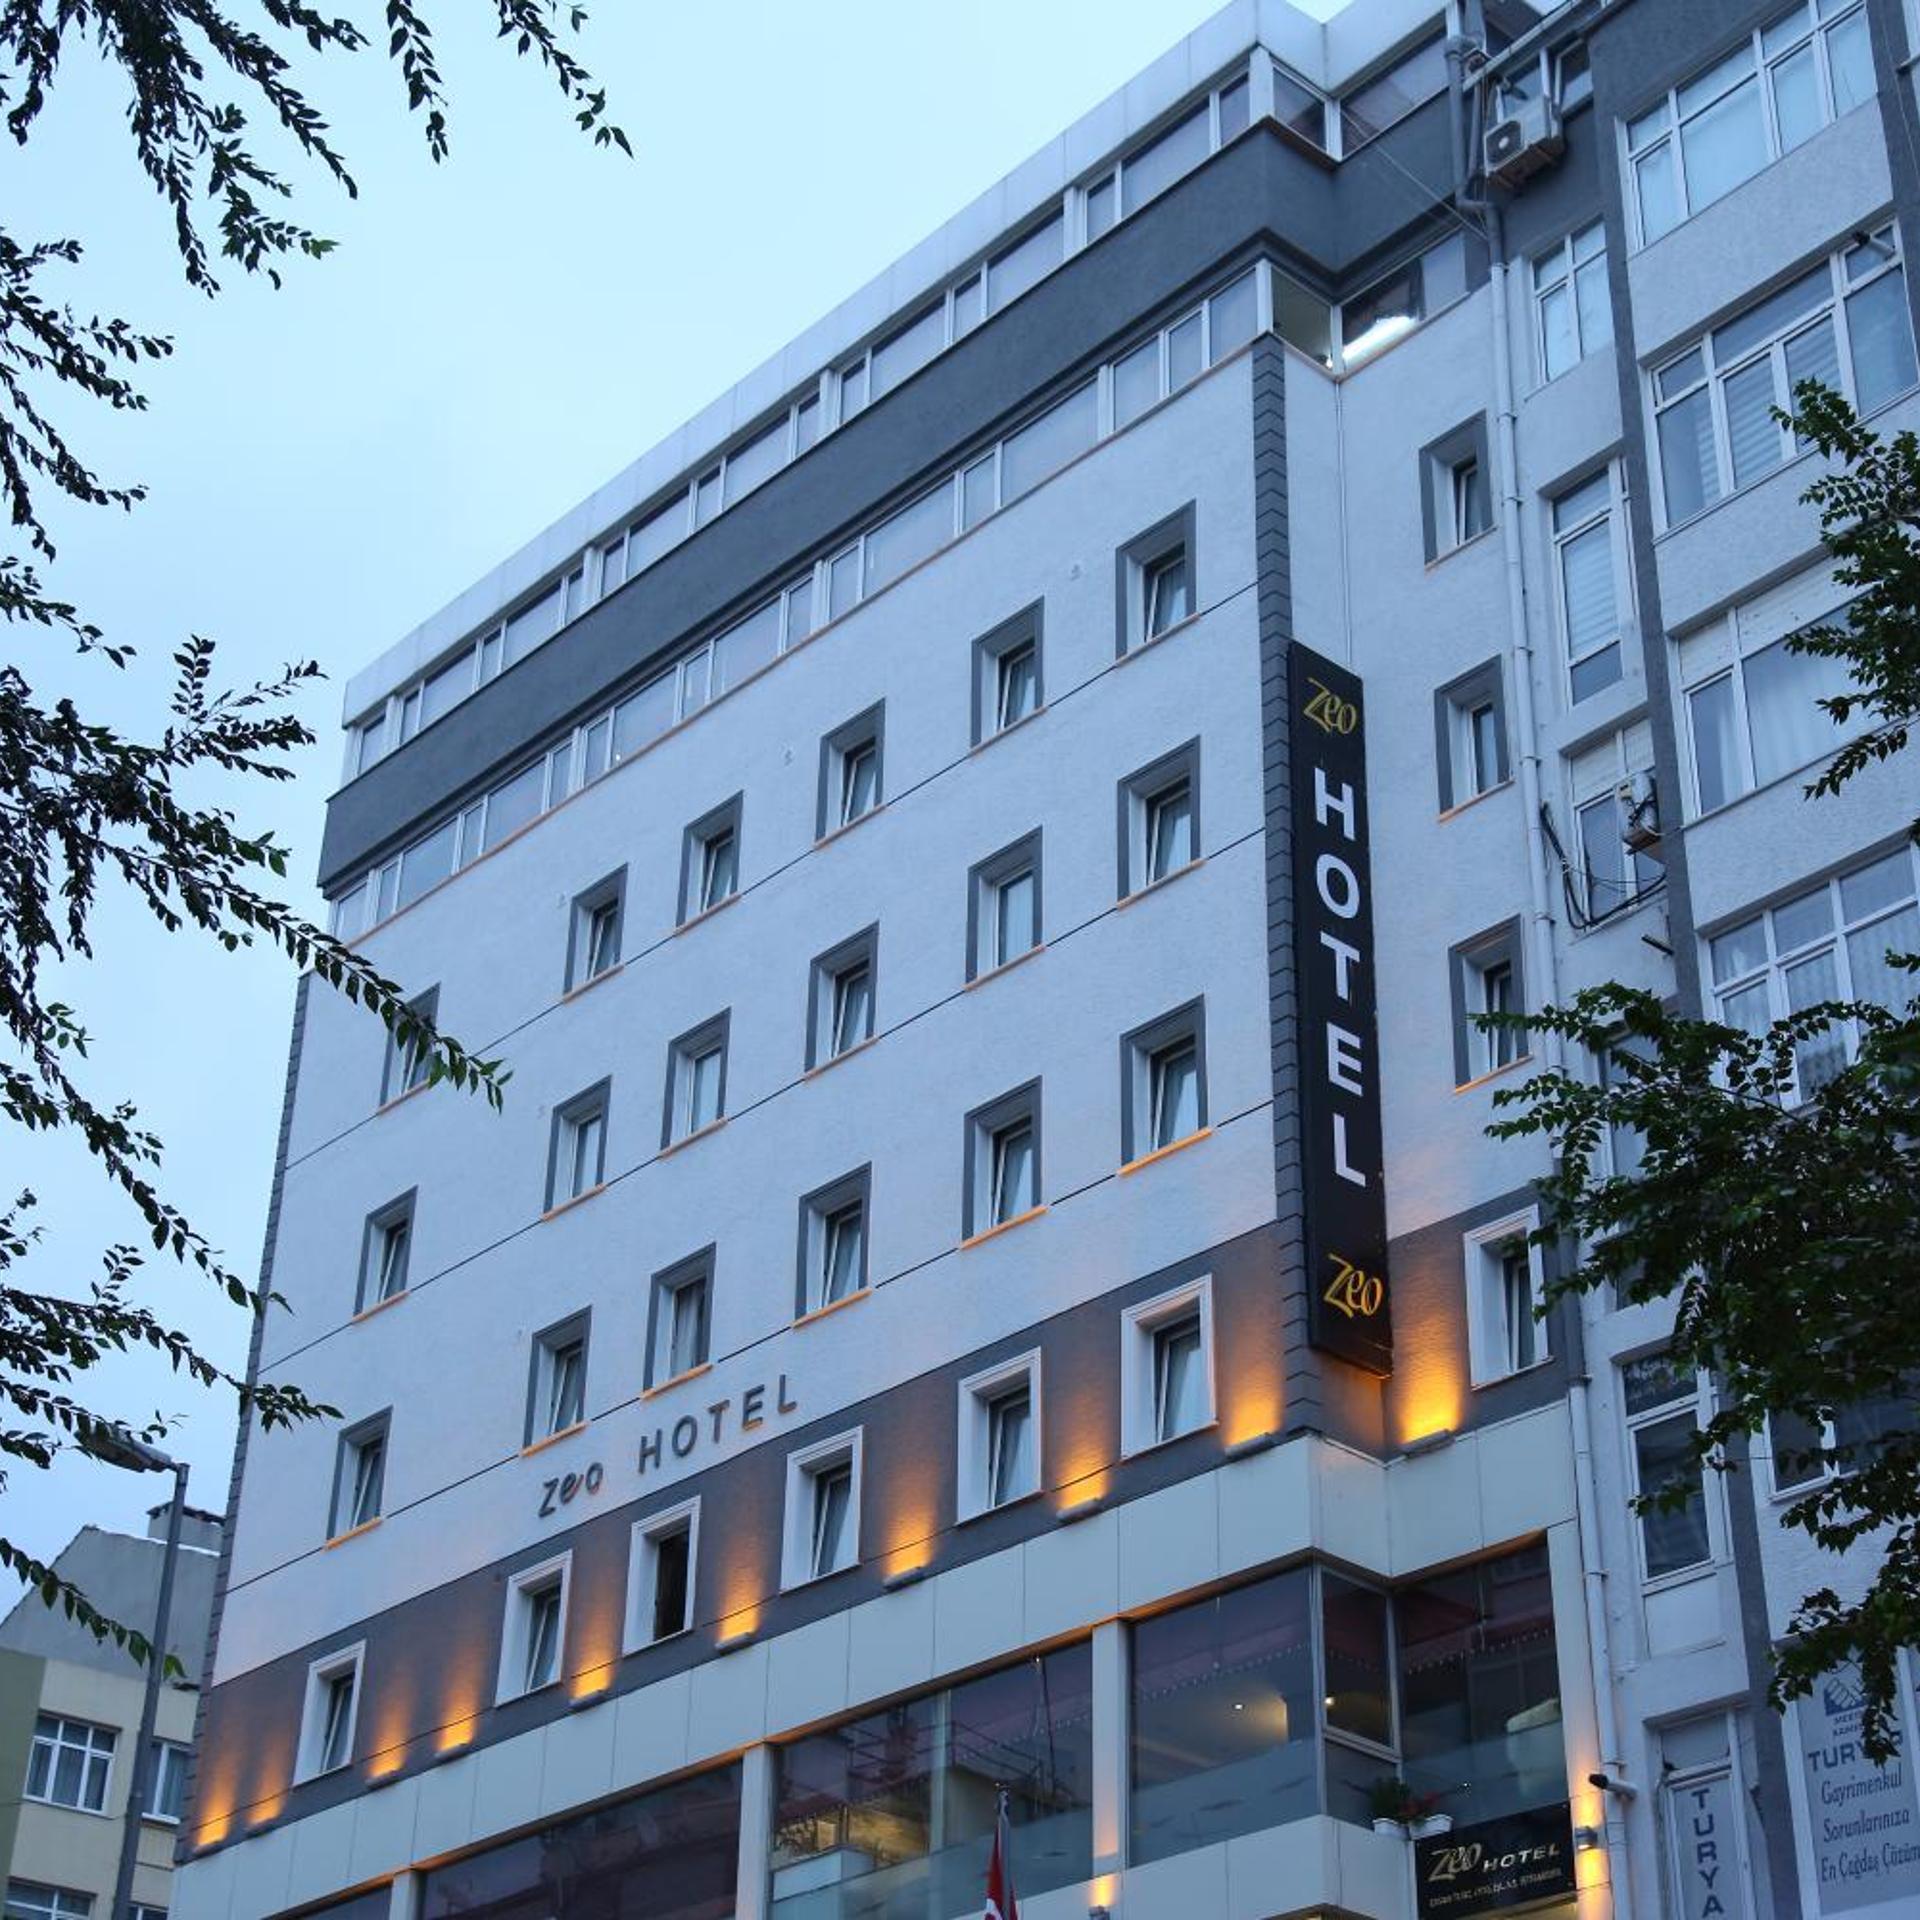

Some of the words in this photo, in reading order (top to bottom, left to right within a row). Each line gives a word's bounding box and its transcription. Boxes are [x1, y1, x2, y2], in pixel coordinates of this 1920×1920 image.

[1314, 767, 1367, 1188] HOTEL
[638, 1374, 798, 1475] HOTEL
[1482, 1843, 1560, 1873] HOTEL
[1821, 1857, 1836, 1882] En
